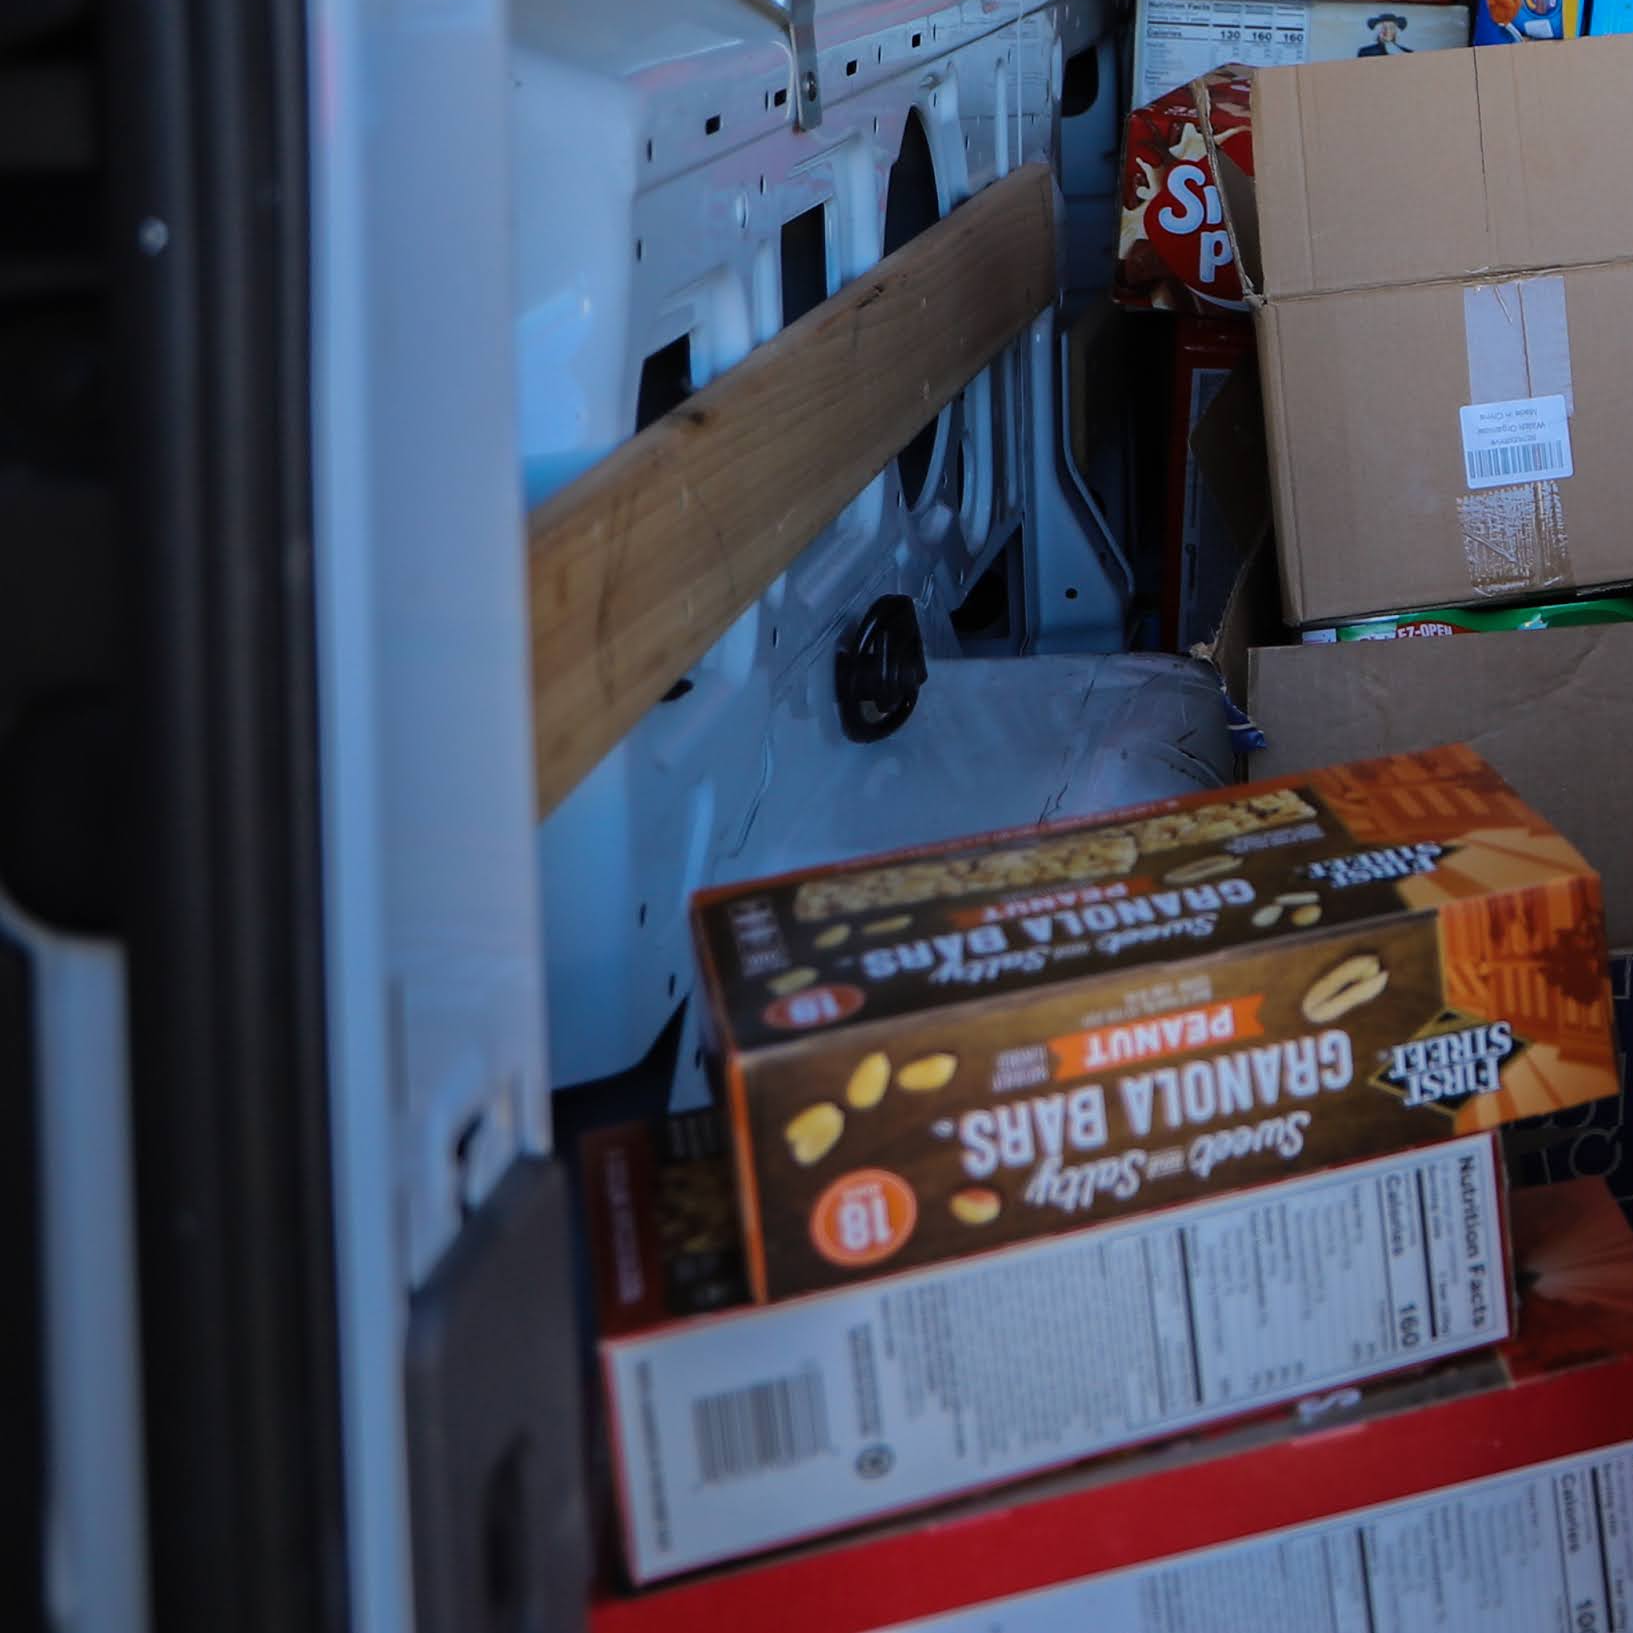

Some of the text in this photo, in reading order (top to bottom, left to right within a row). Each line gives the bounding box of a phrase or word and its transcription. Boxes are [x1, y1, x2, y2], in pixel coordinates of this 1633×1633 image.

[863, 878, 1256, 978] GRANOLA BARS
[983, 882, 1128, 922] PEANUT
[788, 990, 838, 1021] 18
[1084, 1003, 1236, 1067] PEANUT
[1390, 1022, 1512, 1080] STREET
[960, 1030, 1353, 1179] GRANOLA BARS
[1404, 1060, 1502, 1107] FIRST
[838, 1198, 890, 1250] 18
[1458, 1156, 1486, 1329] Nutrition Facts
